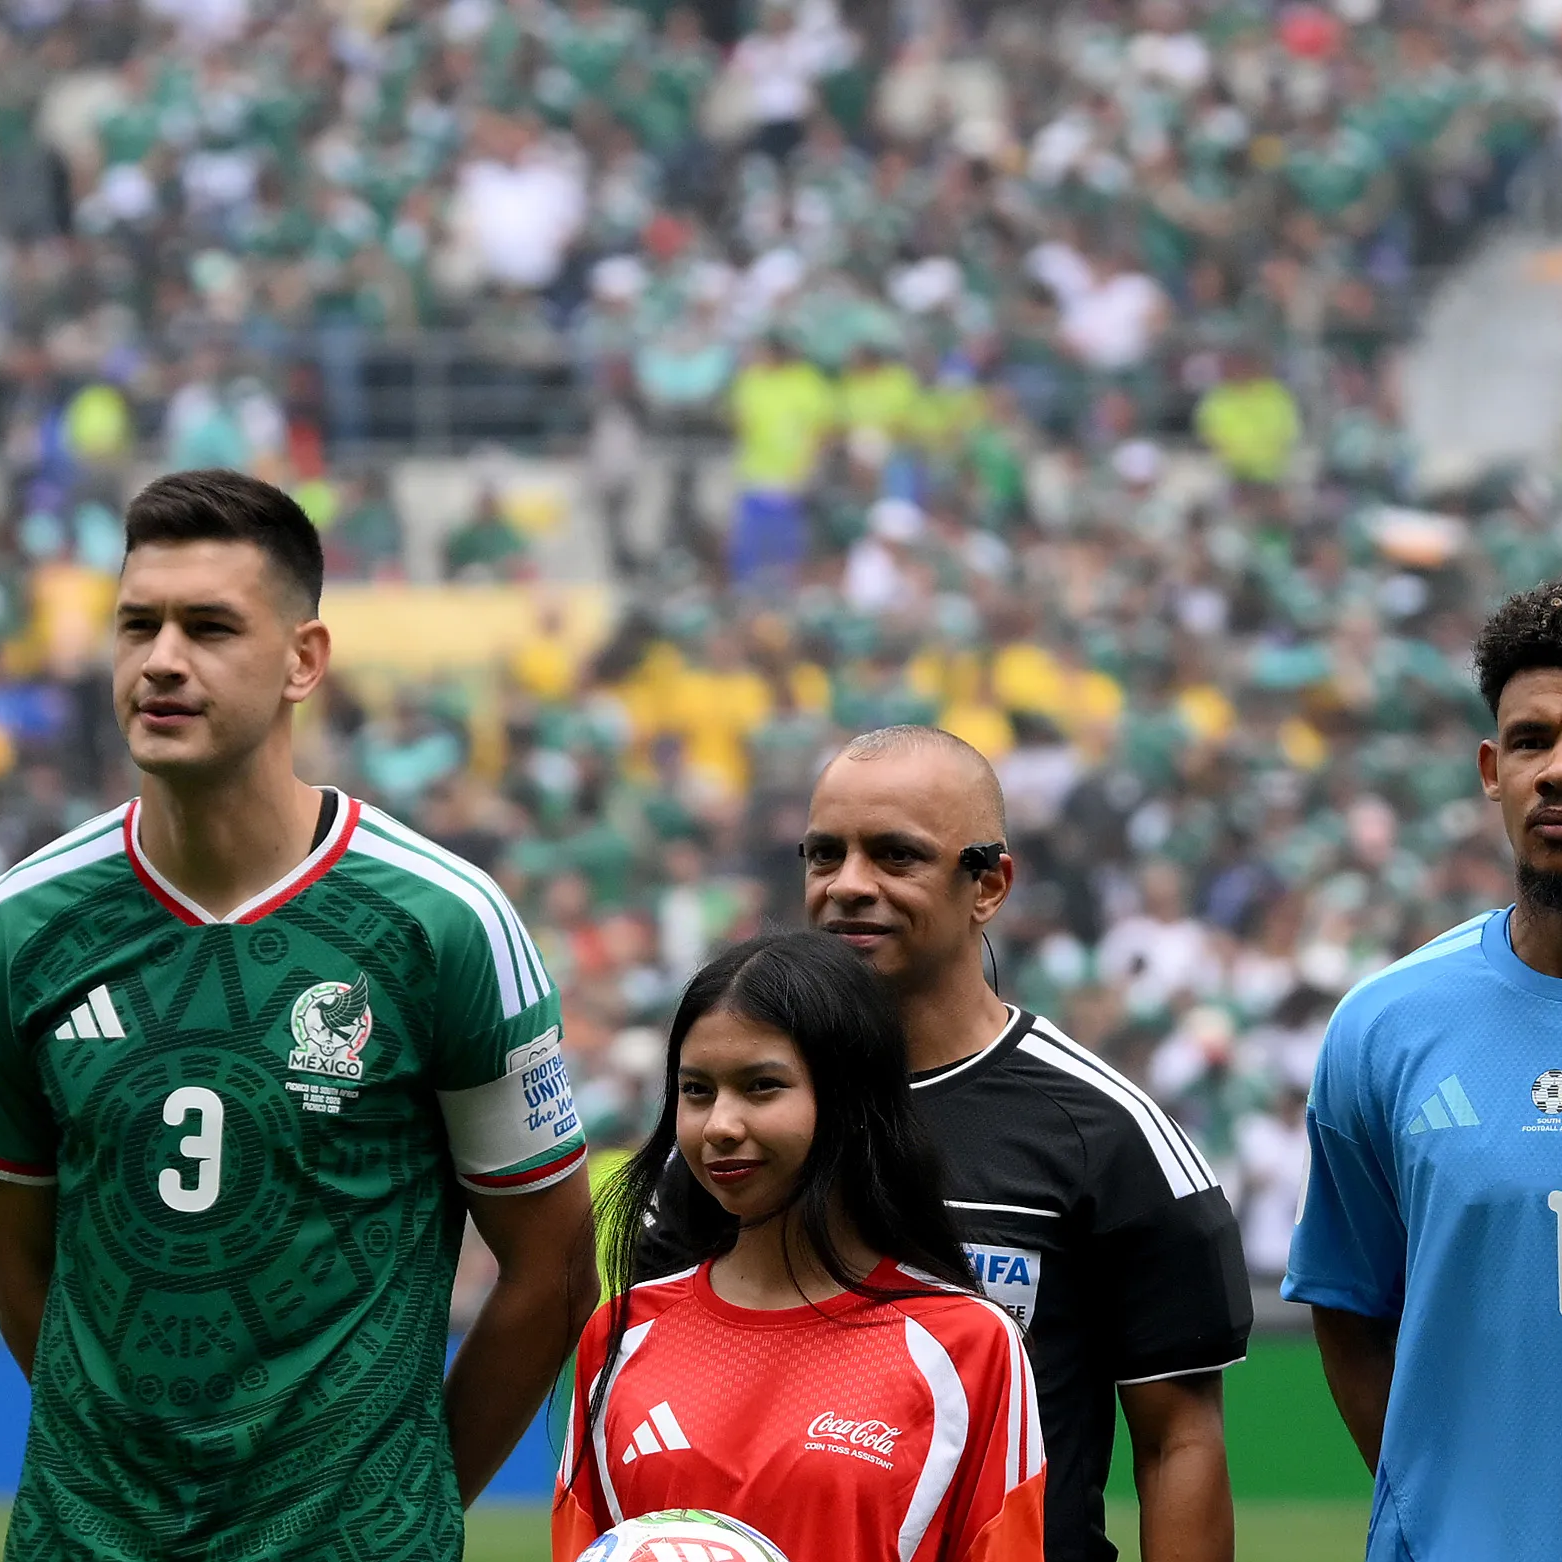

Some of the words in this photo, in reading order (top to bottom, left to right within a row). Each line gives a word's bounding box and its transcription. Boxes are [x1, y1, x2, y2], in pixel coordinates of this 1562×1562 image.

[291, 1053, 360, 1076] MÉXICO
[523, 1108, 556, 1131] the
[557, 1117, 576, 1134] FIFA
[1537, 1117, 1561, 1125] SOUTH
[158, 1086, 224, 1213] 3
[806, 1410, 903, 1457] Coca-Cola
[804, 1442, 826, 1452] COIN
[826, 1443, 850, 1456] TOSS
[850, 1449, 895, 1472] ASSISTANT
